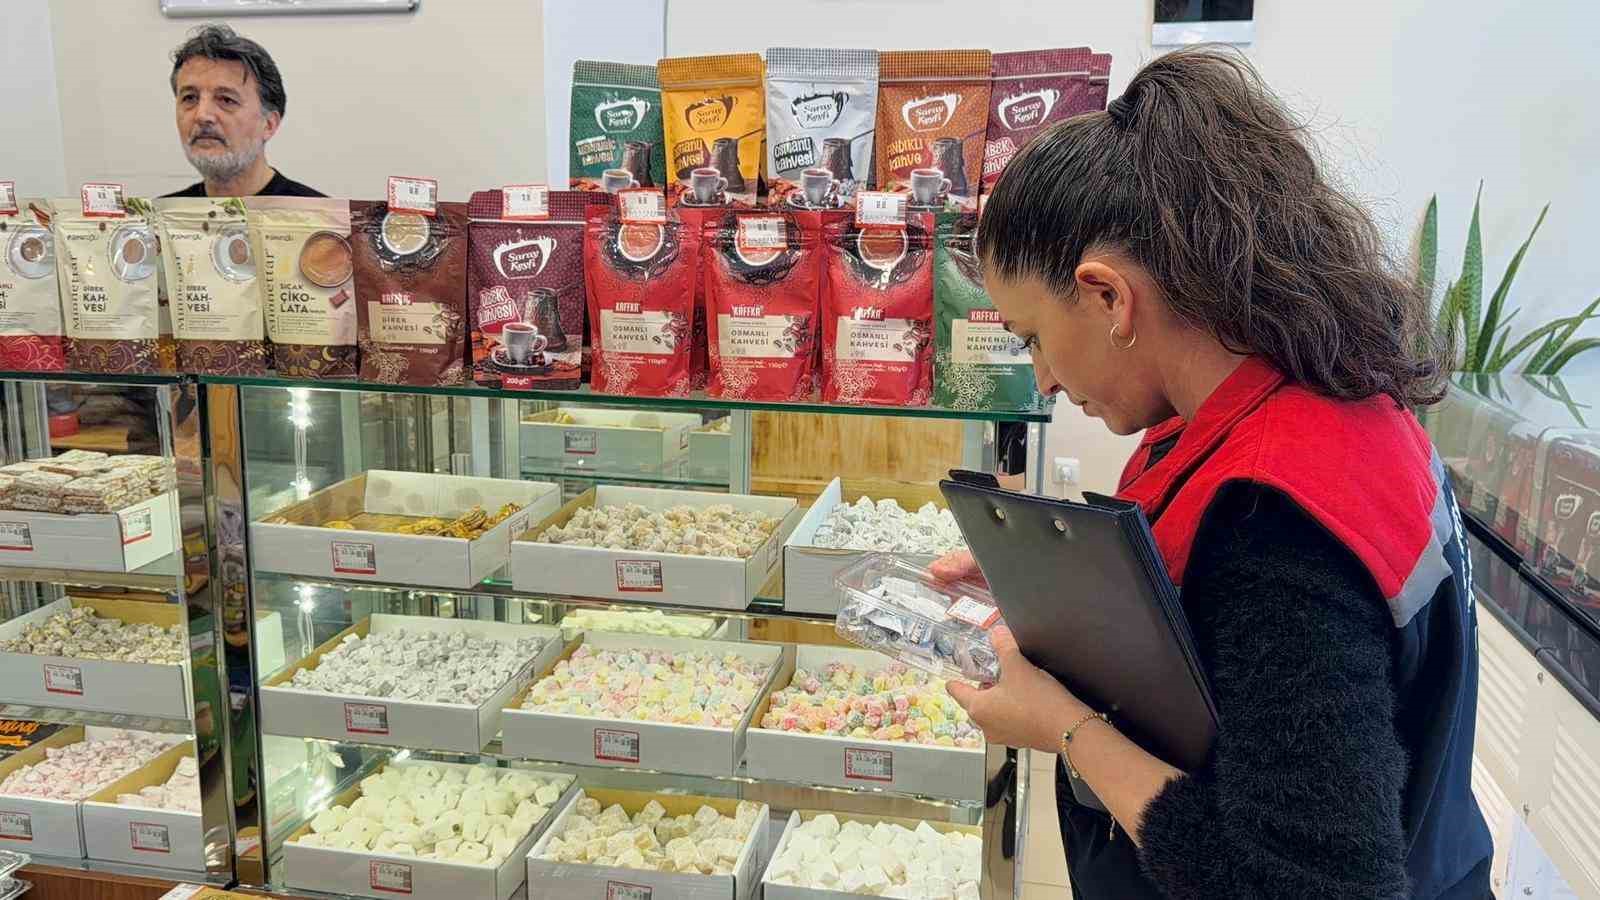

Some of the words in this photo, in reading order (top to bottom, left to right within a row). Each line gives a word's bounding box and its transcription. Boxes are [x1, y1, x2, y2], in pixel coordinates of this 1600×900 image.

[1012, 101, 1042, 115] Saray
[507, 249, 541, 263] Saray
[510, 258, 538, 272] Keyfi
[83, 293, 109, 302] KAH-
[186, 292, 213, 302] KAH-
[279, 290, 316, 305] ÇİKO-
[279, 303, 310, 314] LATA
[615, 302, 641, 313] KAFFKA
[731, 306, 762, 318] KAFFKA
[970, 311, 1000, 321] KAFFKA
[612, 325, 648, 334] OSMANLI
[730, 330, 768, 338] OSMANLI
[612, 333, 648, 342] KAHVESİ
[850, 331, 888, 341] OSMANLI
[730, 338, 769, 347] KAHVESİ
[850, 339, 888, 349] KAHVESİ
